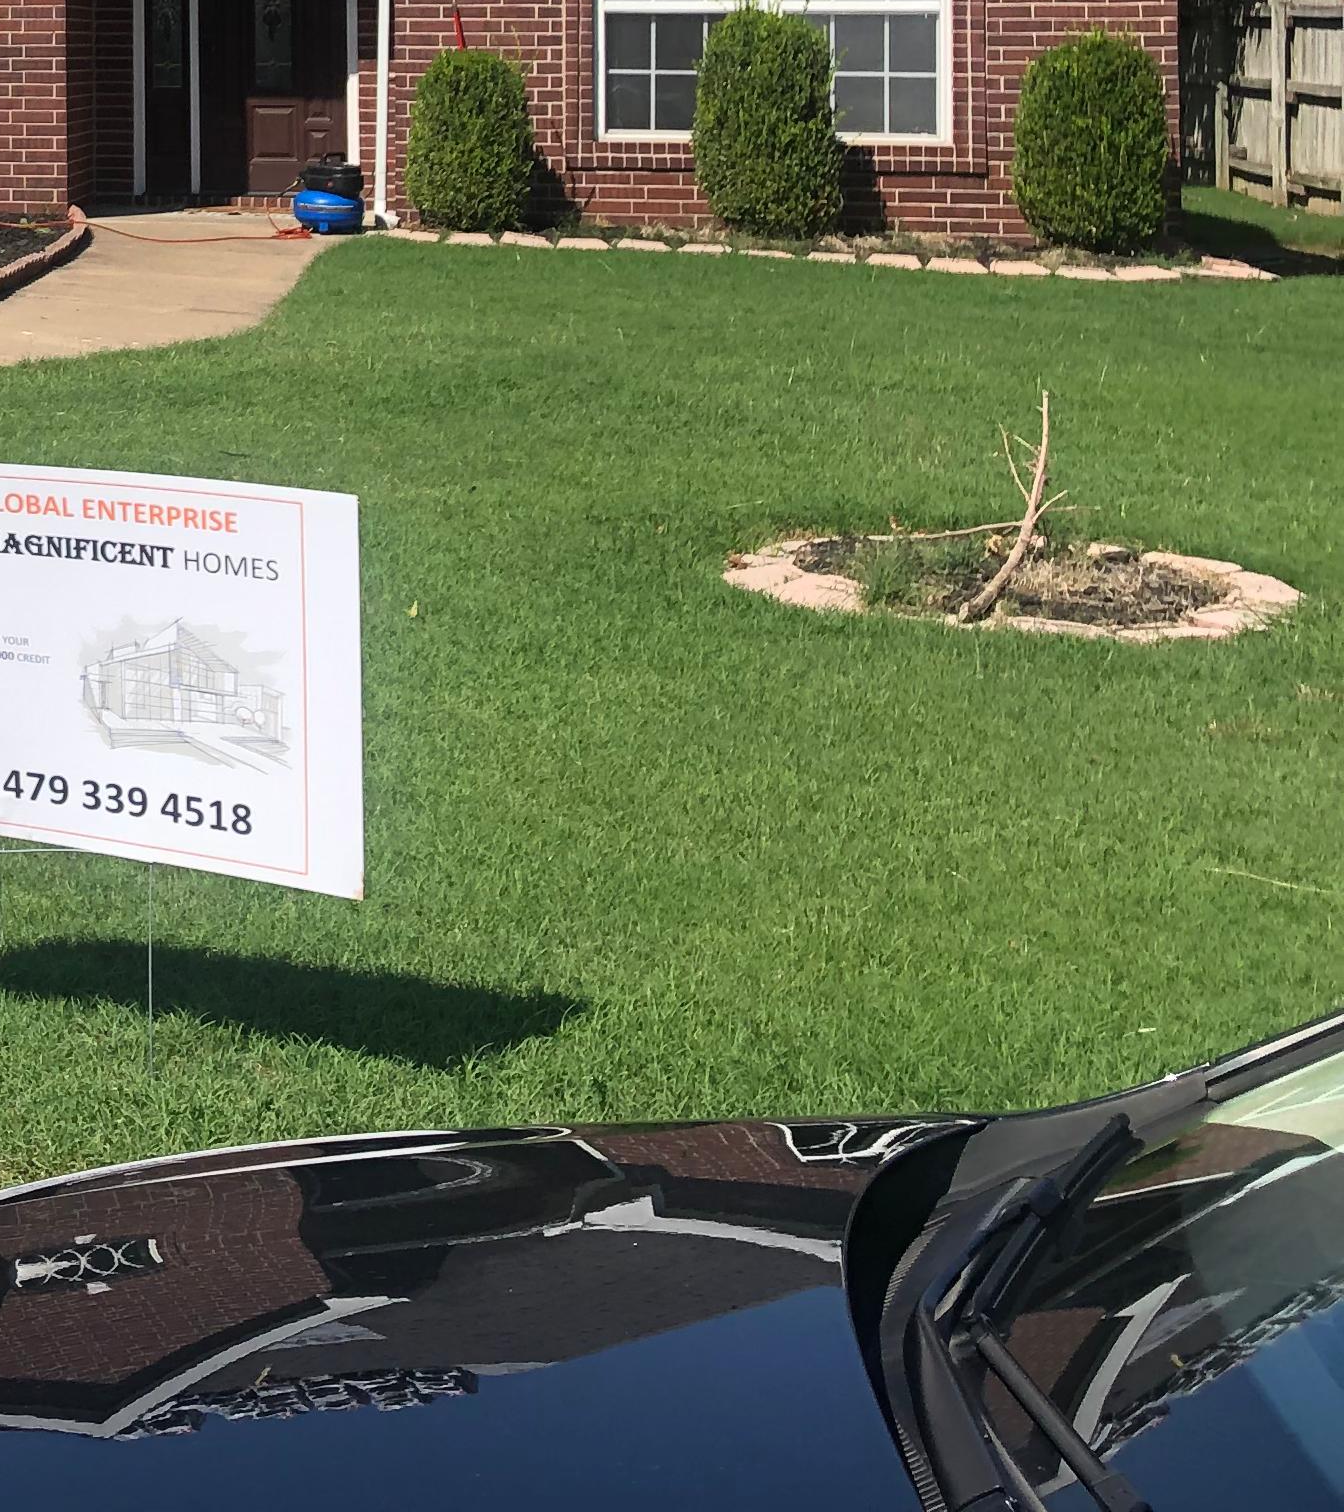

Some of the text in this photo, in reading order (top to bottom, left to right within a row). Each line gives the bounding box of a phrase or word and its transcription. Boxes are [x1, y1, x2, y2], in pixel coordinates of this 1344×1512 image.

[82, 498, 239, 533] ENTERPRISE
[183, 549, 280, 581] HOMES
[2, 636, 30, 647] YOUR
[17, 653, 50, 664] CREDIT
[2, 769, 69, 805] 479
[81, 779, 148, 818] 339
[160, 792, 253, 836] 4518
